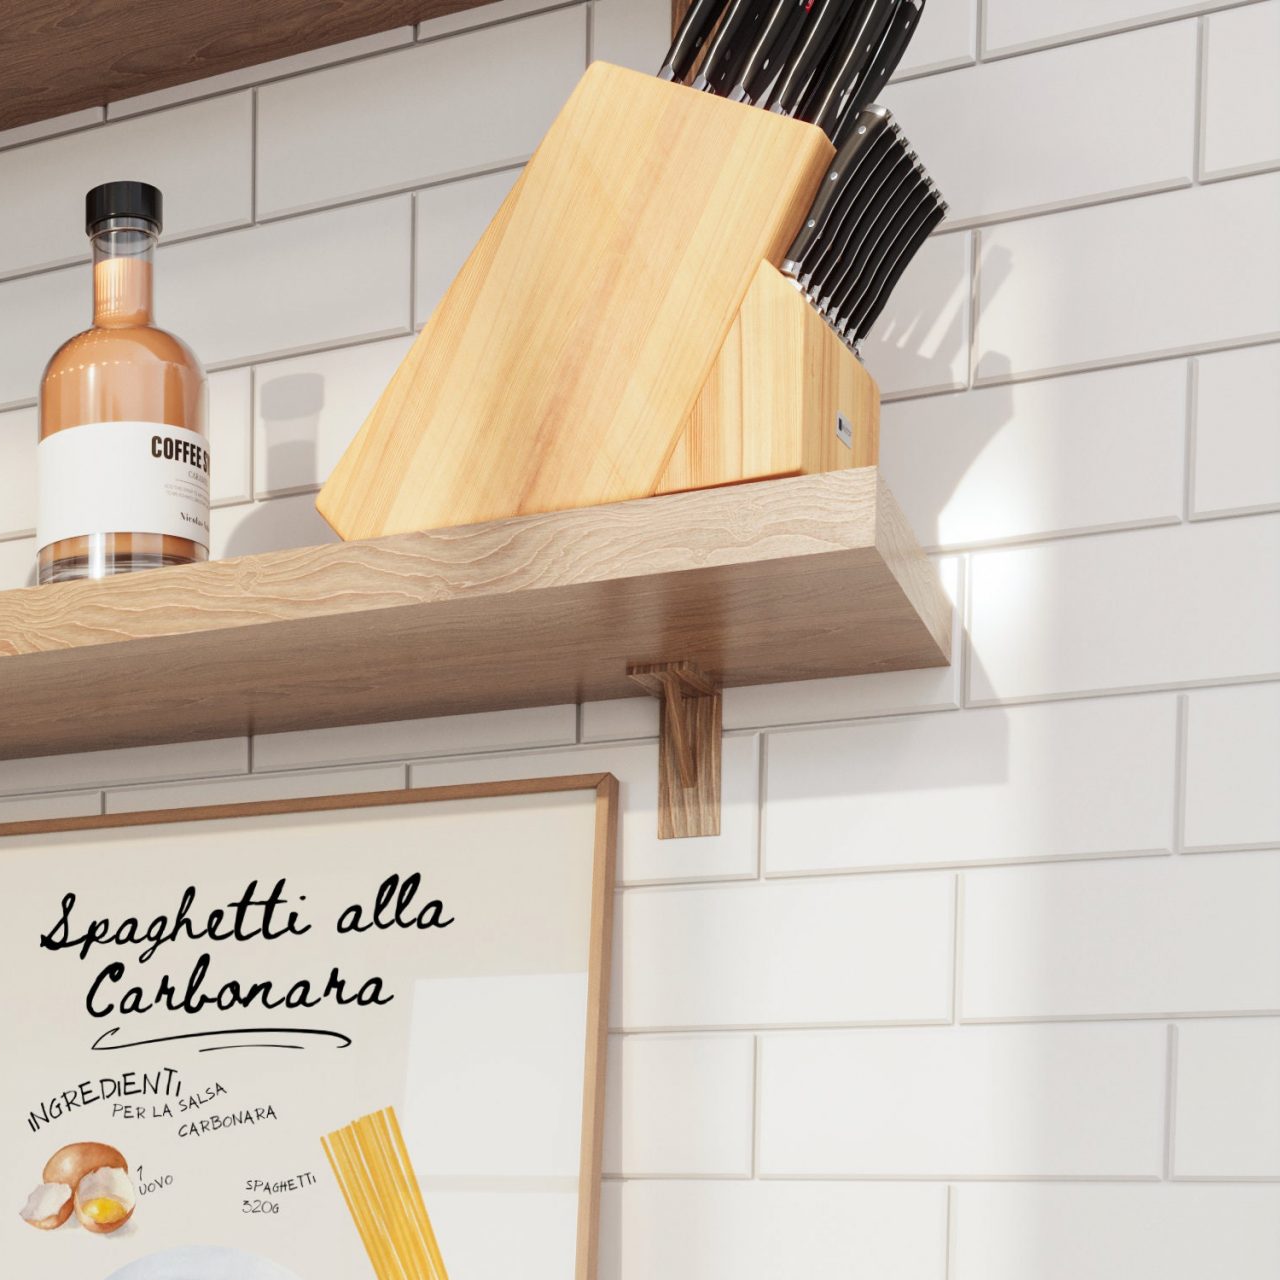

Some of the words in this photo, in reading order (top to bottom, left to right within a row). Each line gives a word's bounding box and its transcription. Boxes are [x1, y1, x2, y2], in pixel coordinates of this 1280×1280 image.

[152, 436, 202, 469] COFFEE
[41, 878, 311, 963] Spaghetti
[337, 872, 455, 933] alla
[86, 953, 394, 1018] Carbonara
[28, 1067, 181, 1132] INGREDIENTI
[112, 1103, 146, 1119] PER
[152, 1103, 173, 1118] LA
[178, 1082, 227, 1112] SALSA
[178, 1105, 277, 1137] CARBONARA
[137, 1165, 143, 1181] 1
[139, 1175, 173, 1195] UOVO
[245, 1172, 317, 1195] SPAGHETTI
[242, 1199, 279, 1214] 320G
